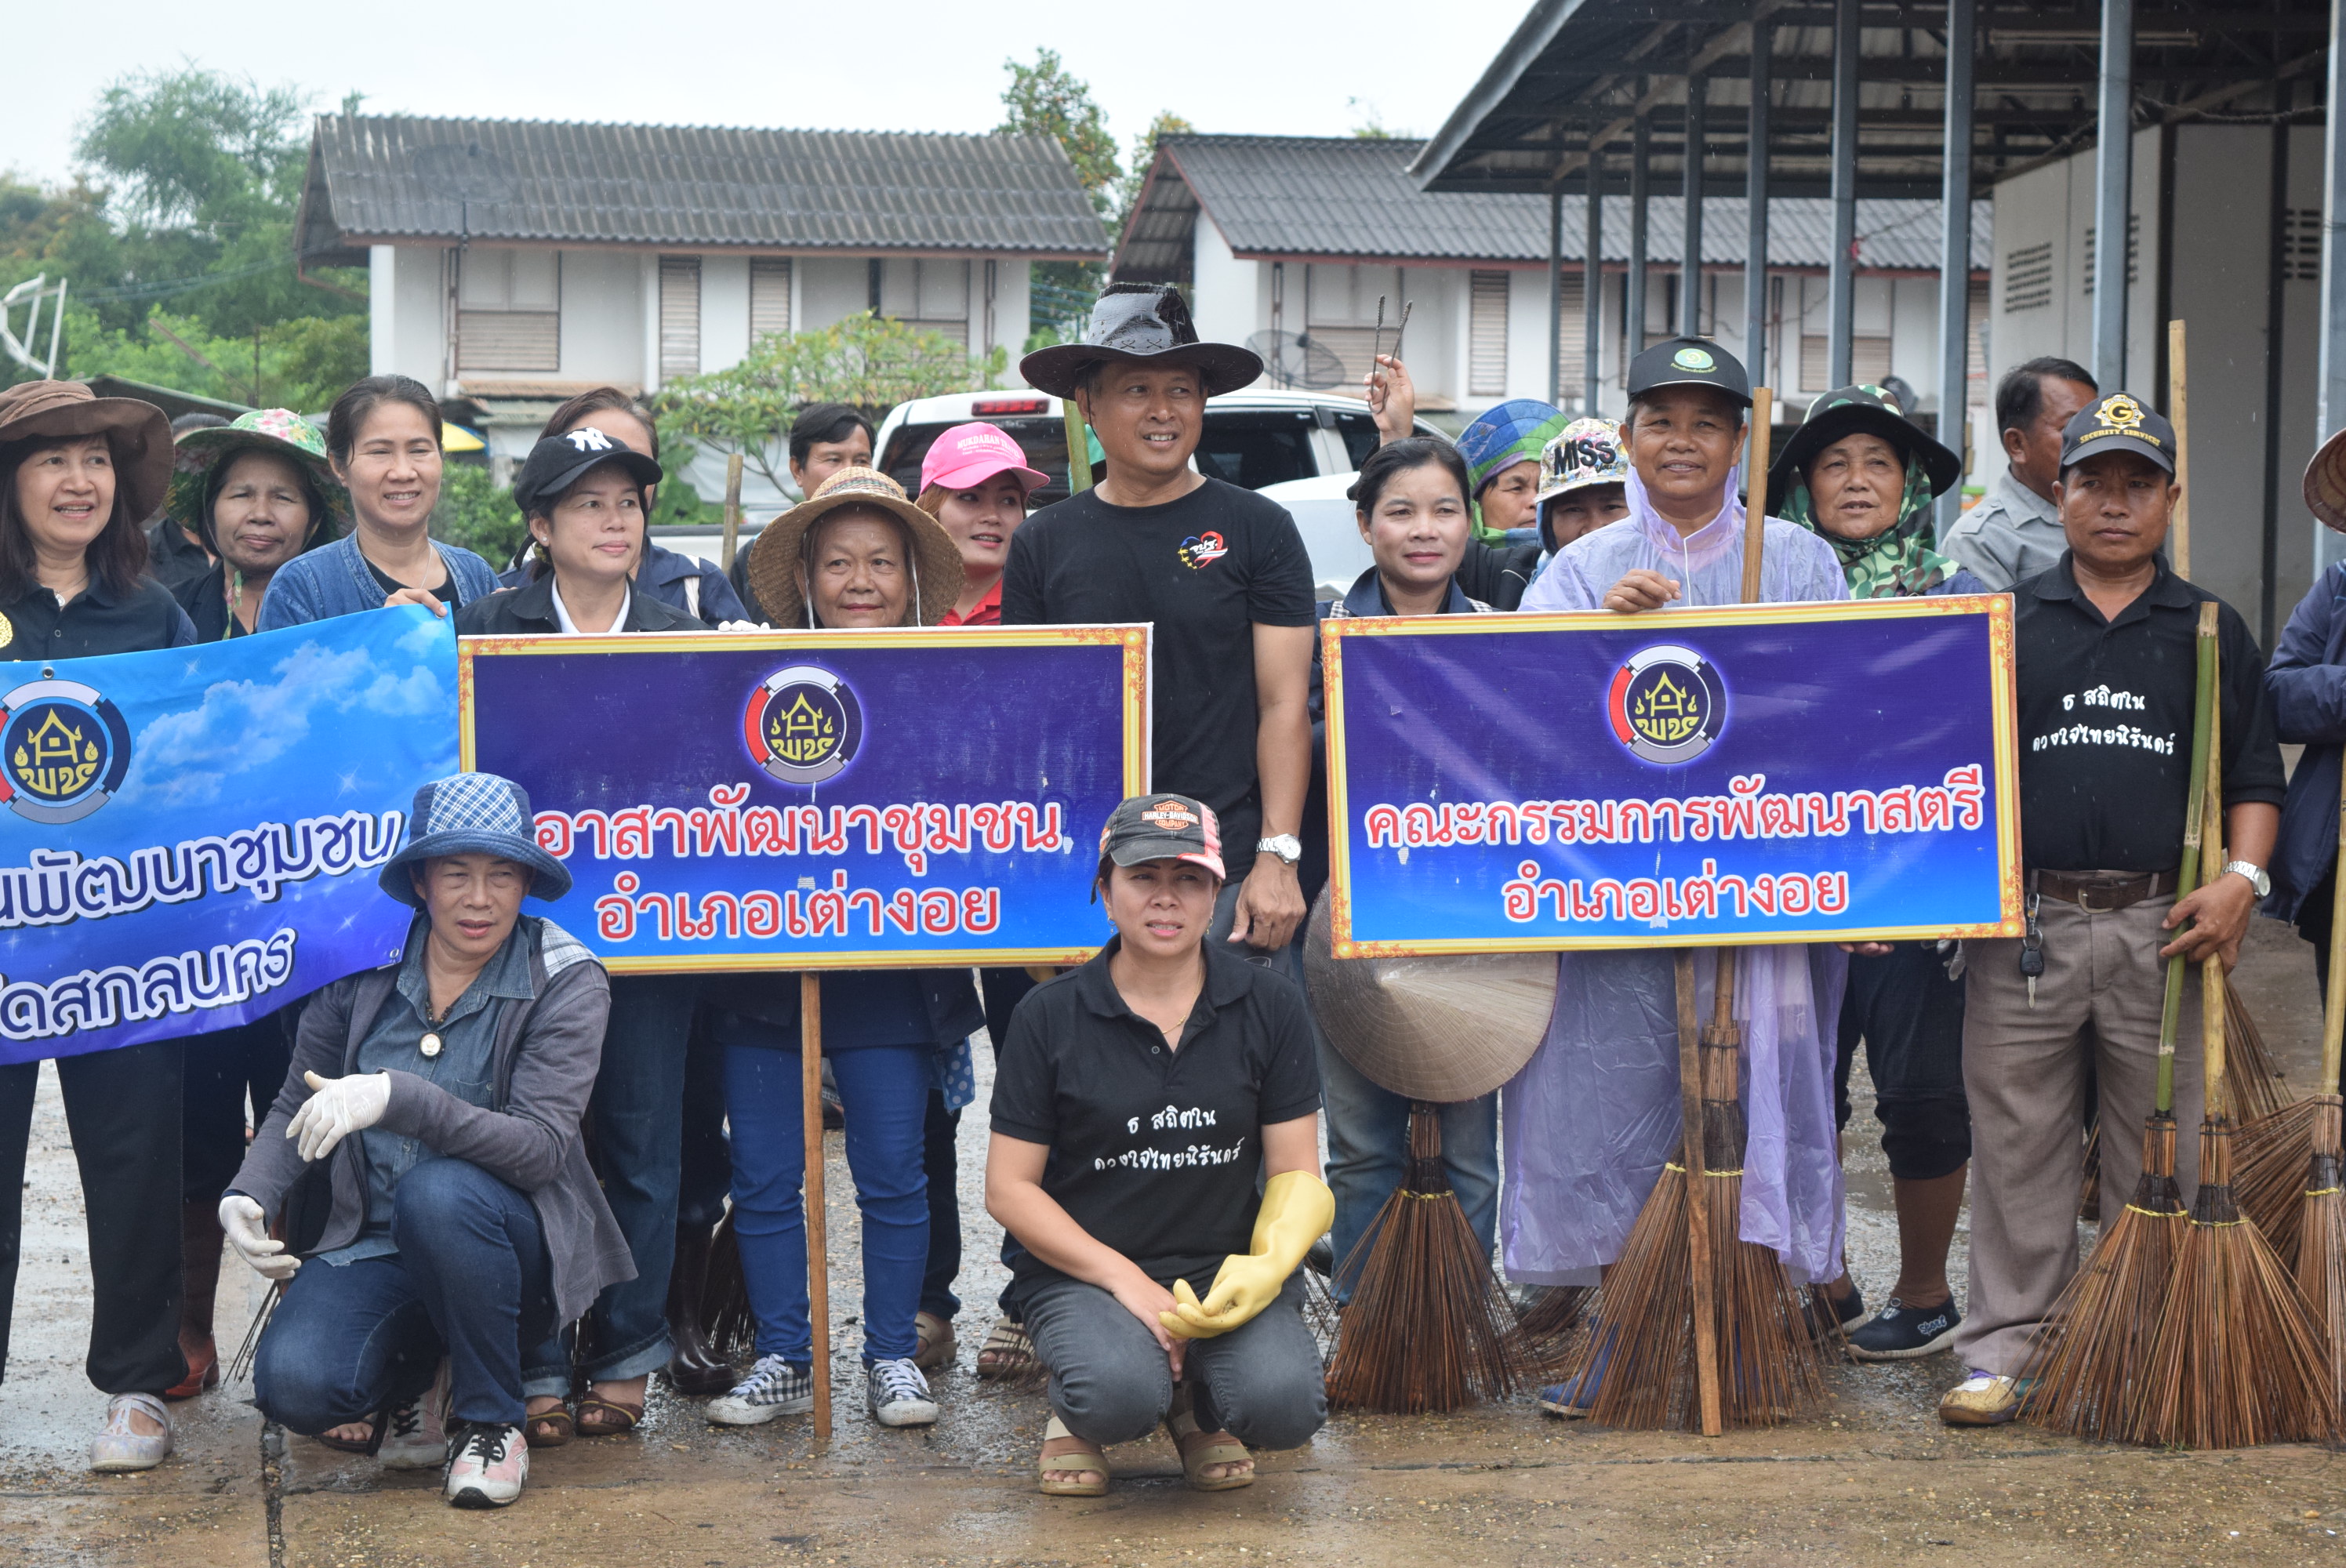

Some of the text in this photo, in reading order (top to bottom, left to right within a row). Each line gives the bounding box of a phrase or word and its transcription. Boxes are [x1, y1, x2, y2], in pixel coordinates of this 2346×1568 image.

[2107, 401, 2134, 422] G
[957, 434, 1000, 449] MUKDAHAN
[1554, 438, 1616, 476] MISS
[2079, 429, 2161, 447] SECURITY SERVICES
[1144, 811, 1197, 822] HARLEY-DAVIDSON
[1158, 819, 1186, 828] COMPANY
[1366, 766, 1985, 848] คณะกรรมการพัฒนาสตรี
[534, 785, 1061, 874] อาสาพัฒนาชุมชน
[596, 872, 999, 941] อำเภอเต่างอย
[1503, 860, 1848, 922] อำเภอเต่างอย
[0, 930, 295, 1036] ดสกลนคร
